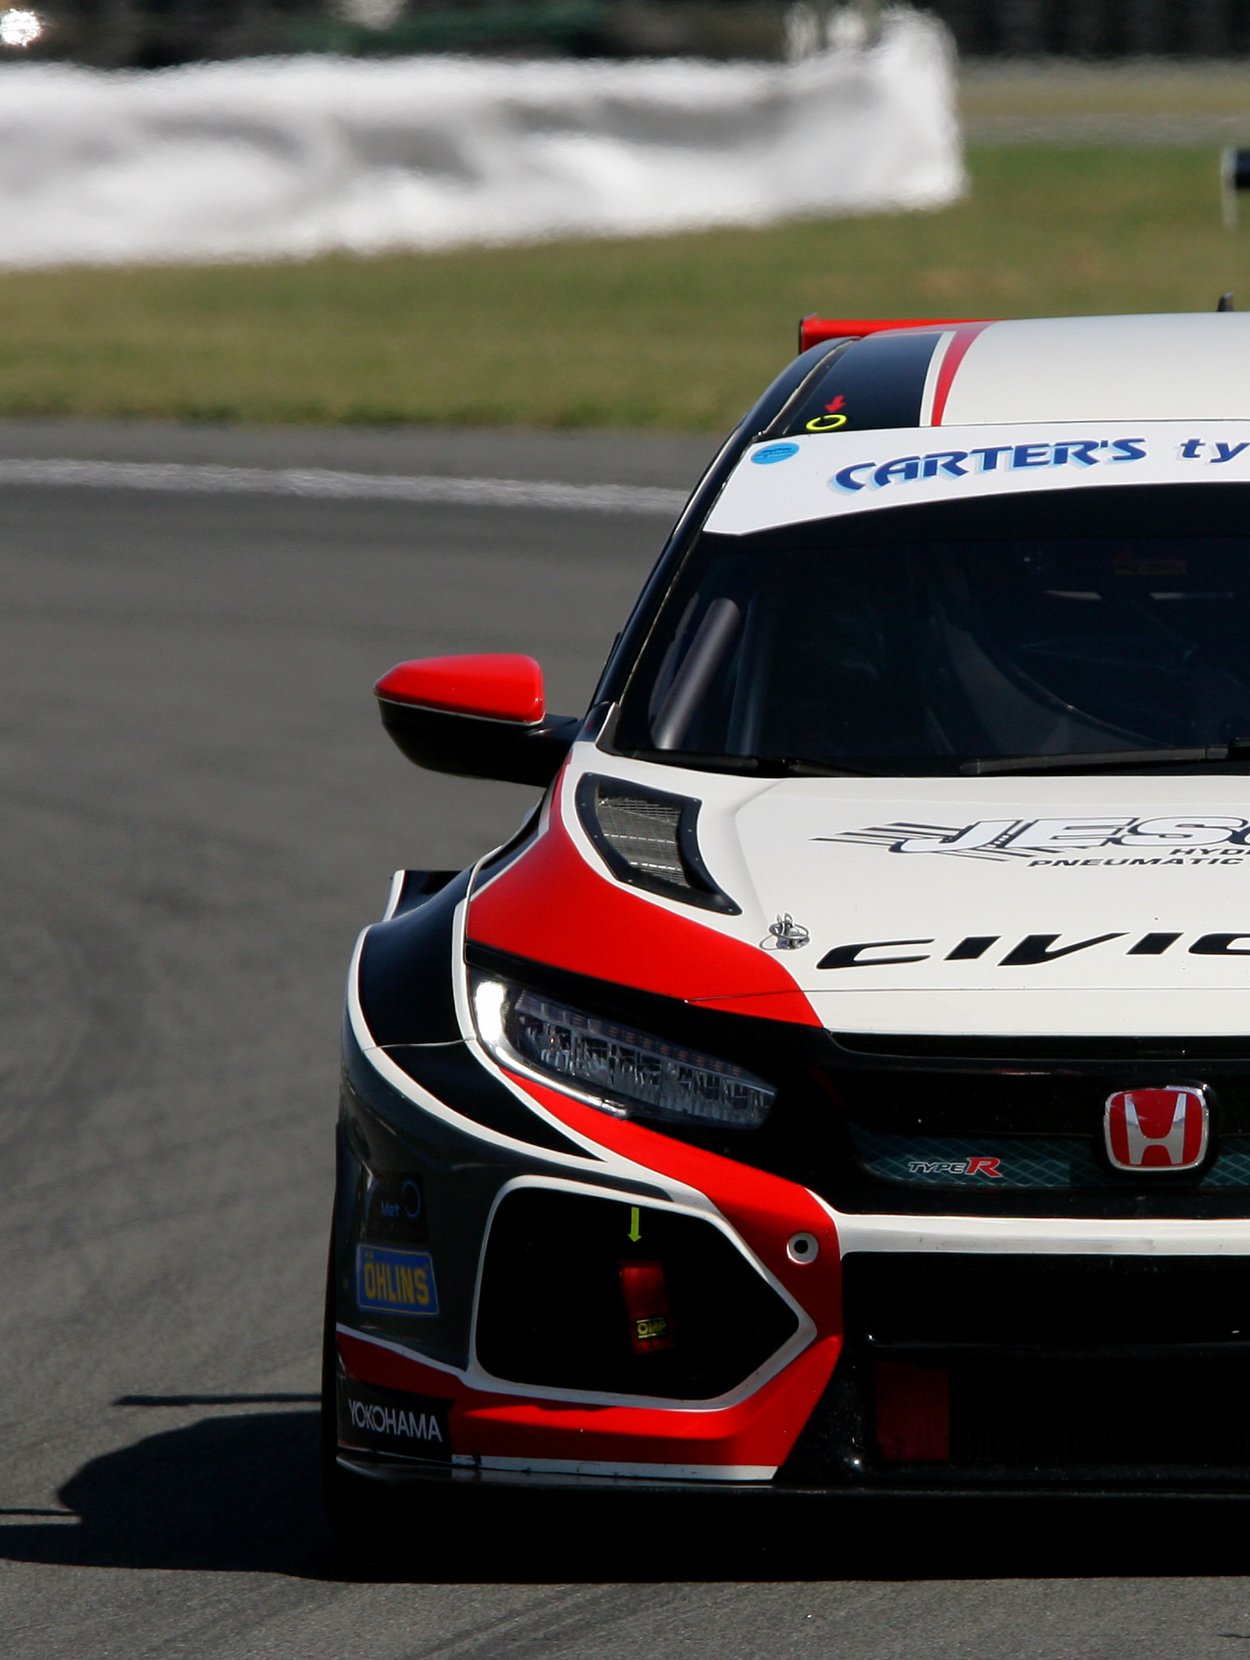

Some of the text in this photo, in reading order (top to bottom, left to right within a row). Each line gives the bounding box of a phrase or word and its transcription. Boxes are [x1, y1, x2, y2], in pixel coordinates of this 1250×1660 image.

[830, 438, 1147, 493] CARTER'S
[1028, 857, 1244, 867] PNEUMATIC
[364, 1253, 429, 1305] ÖHLINS
[348, 1399, 442, 1442] YOKOHAMA
